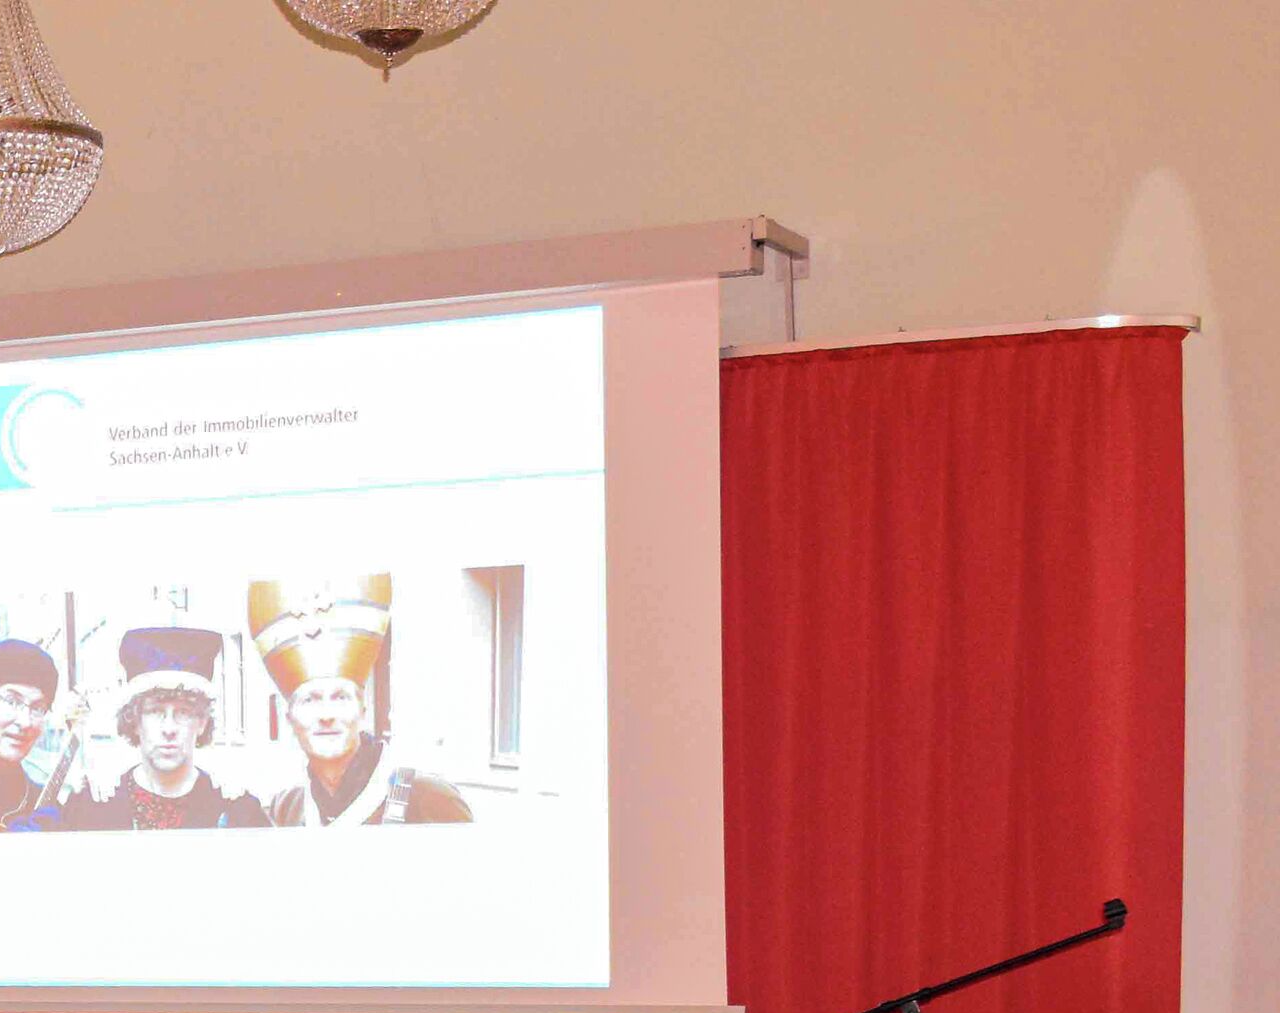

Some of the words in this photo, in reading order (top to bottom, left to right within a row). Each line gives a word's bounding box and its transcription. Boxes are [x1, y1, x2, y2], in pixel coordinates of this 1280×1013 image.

[109, 421, 168, 441] Verband
[174, 420, 197, 436] der
[203, 407, 359, 433] Immobilienverwalter
[109, 443, 220, 466] Sachsen-Anhalt
